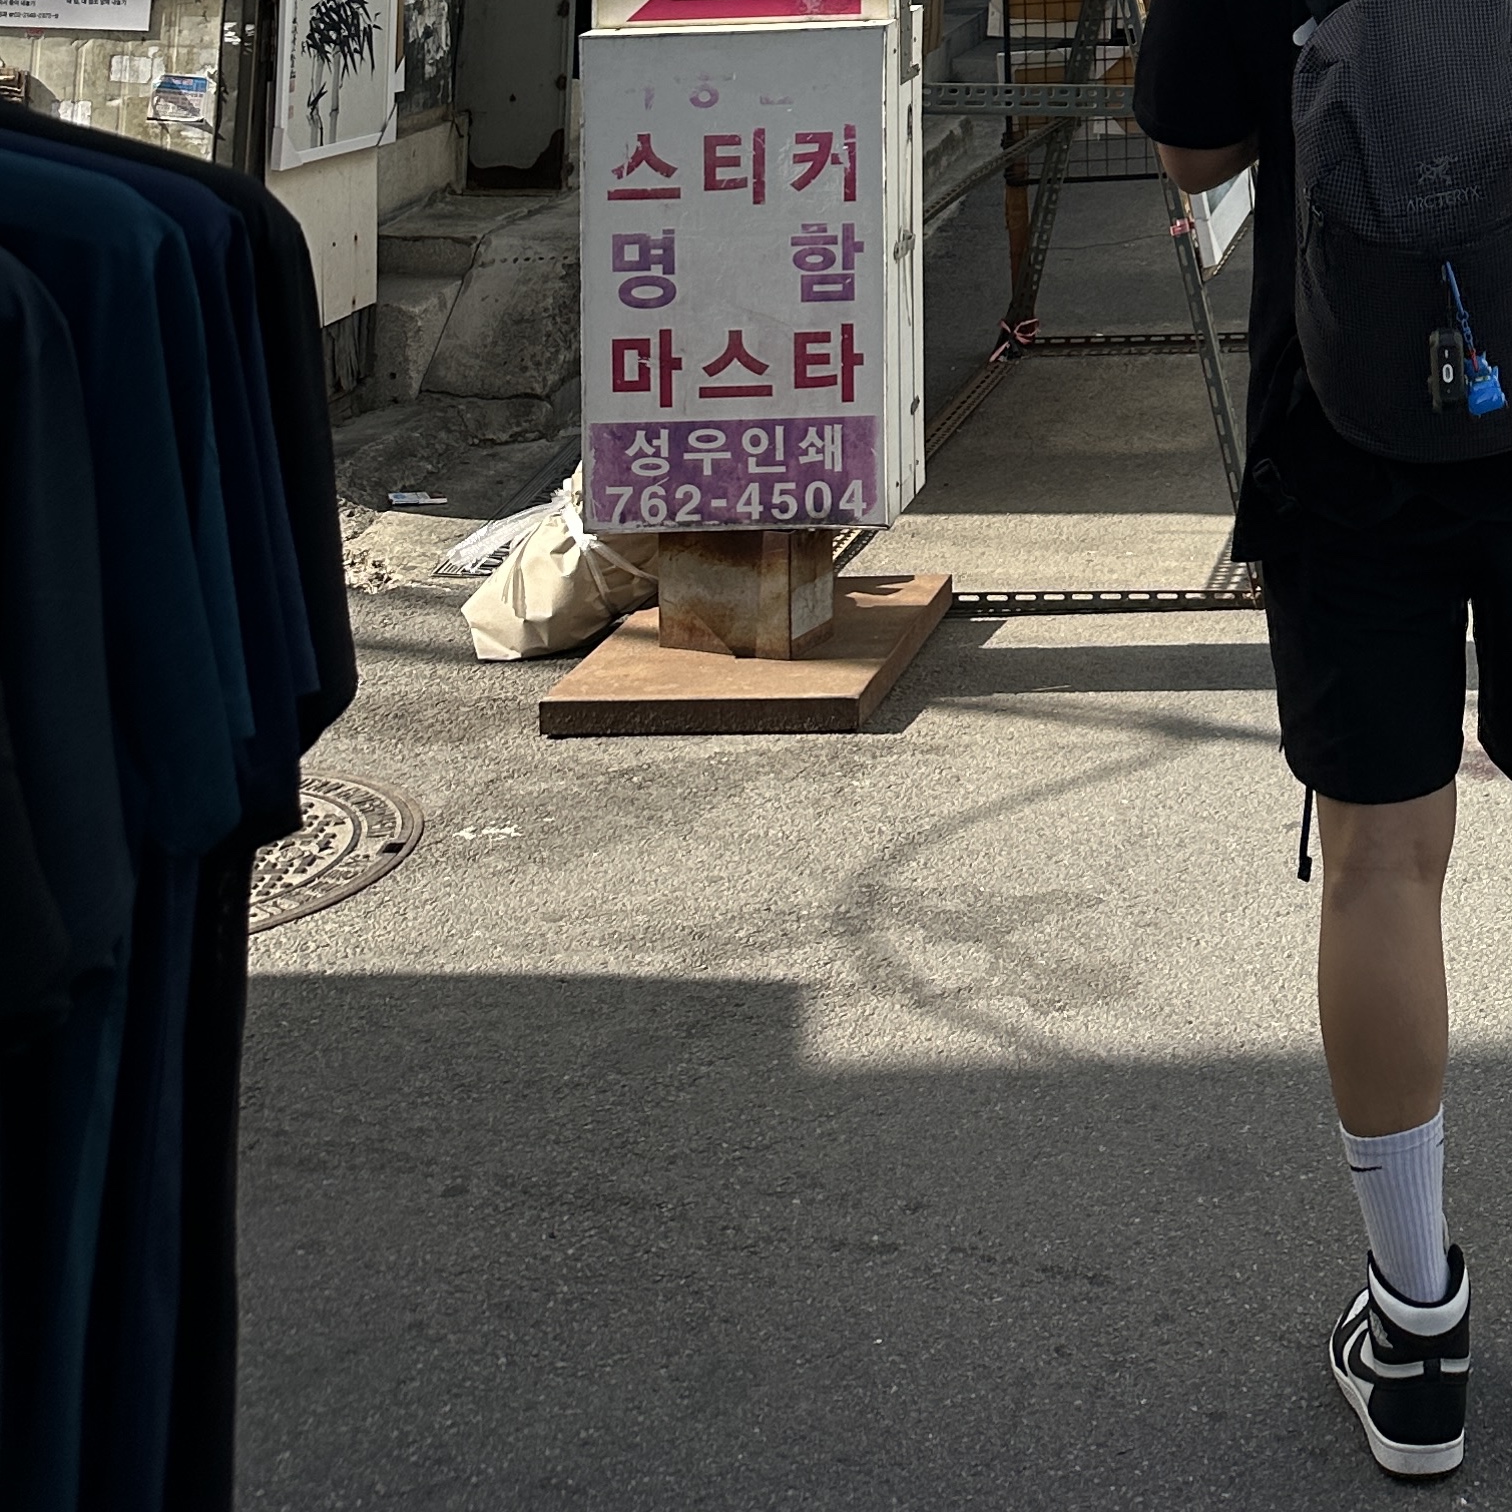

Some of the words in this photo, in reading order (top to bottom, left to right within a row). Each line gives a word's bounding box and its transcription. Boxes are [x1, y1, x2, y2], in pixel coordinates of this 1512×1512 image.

[606, 123, 859, 206] 스티커
[611, 222, 866, 310] 명함
[610, 322, 865, 408] 마스타
[623, 424, 844, 474] 성우인쇄
[605, 478, 869, 525] 762-4504
